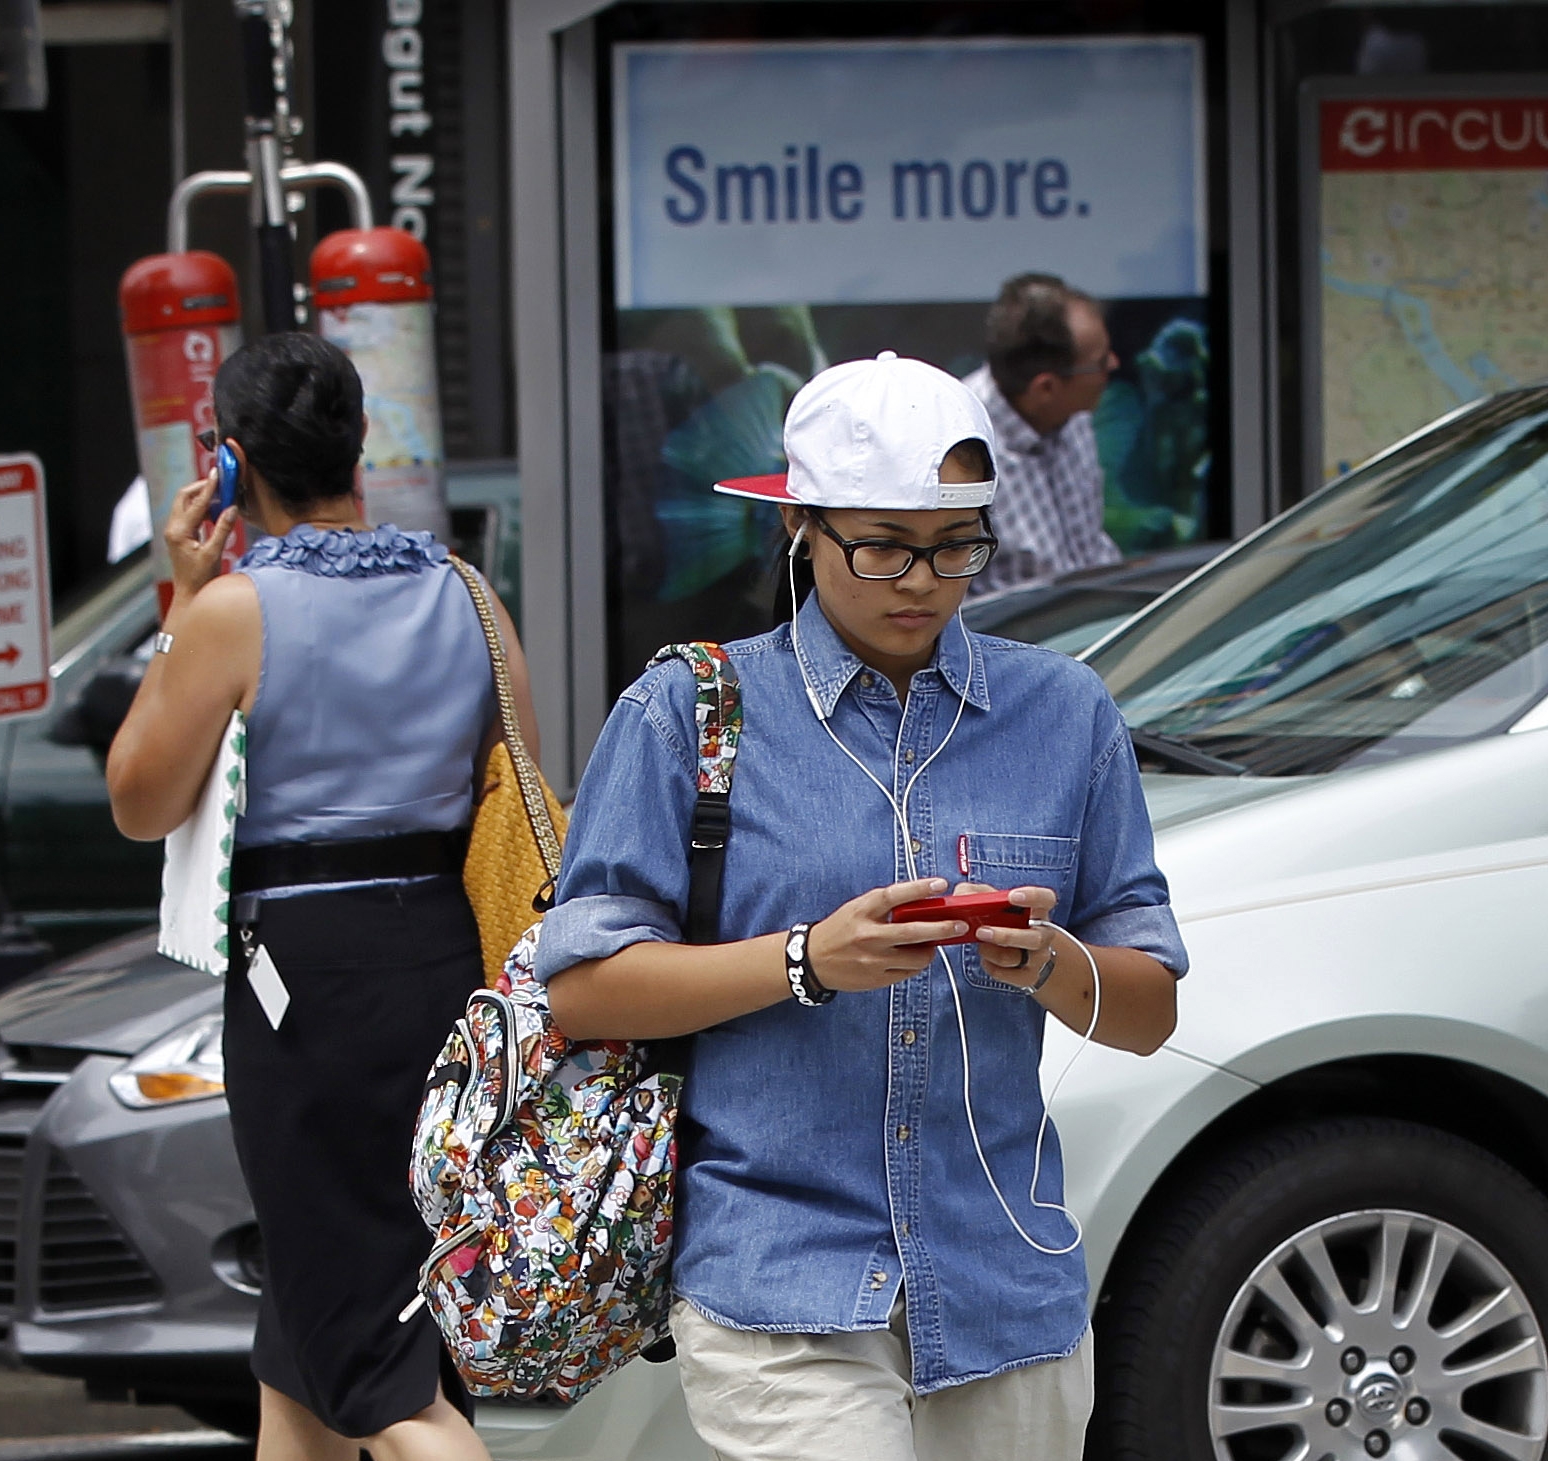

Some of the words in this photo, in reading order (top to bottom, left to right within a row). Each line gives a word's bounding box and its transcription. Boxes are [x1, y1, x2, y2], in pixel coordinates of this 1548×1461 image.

[664, 144, 864, 226] Smile
[892, 156, 1091, 220] more.
[788, 965, 823, 1007] boo
